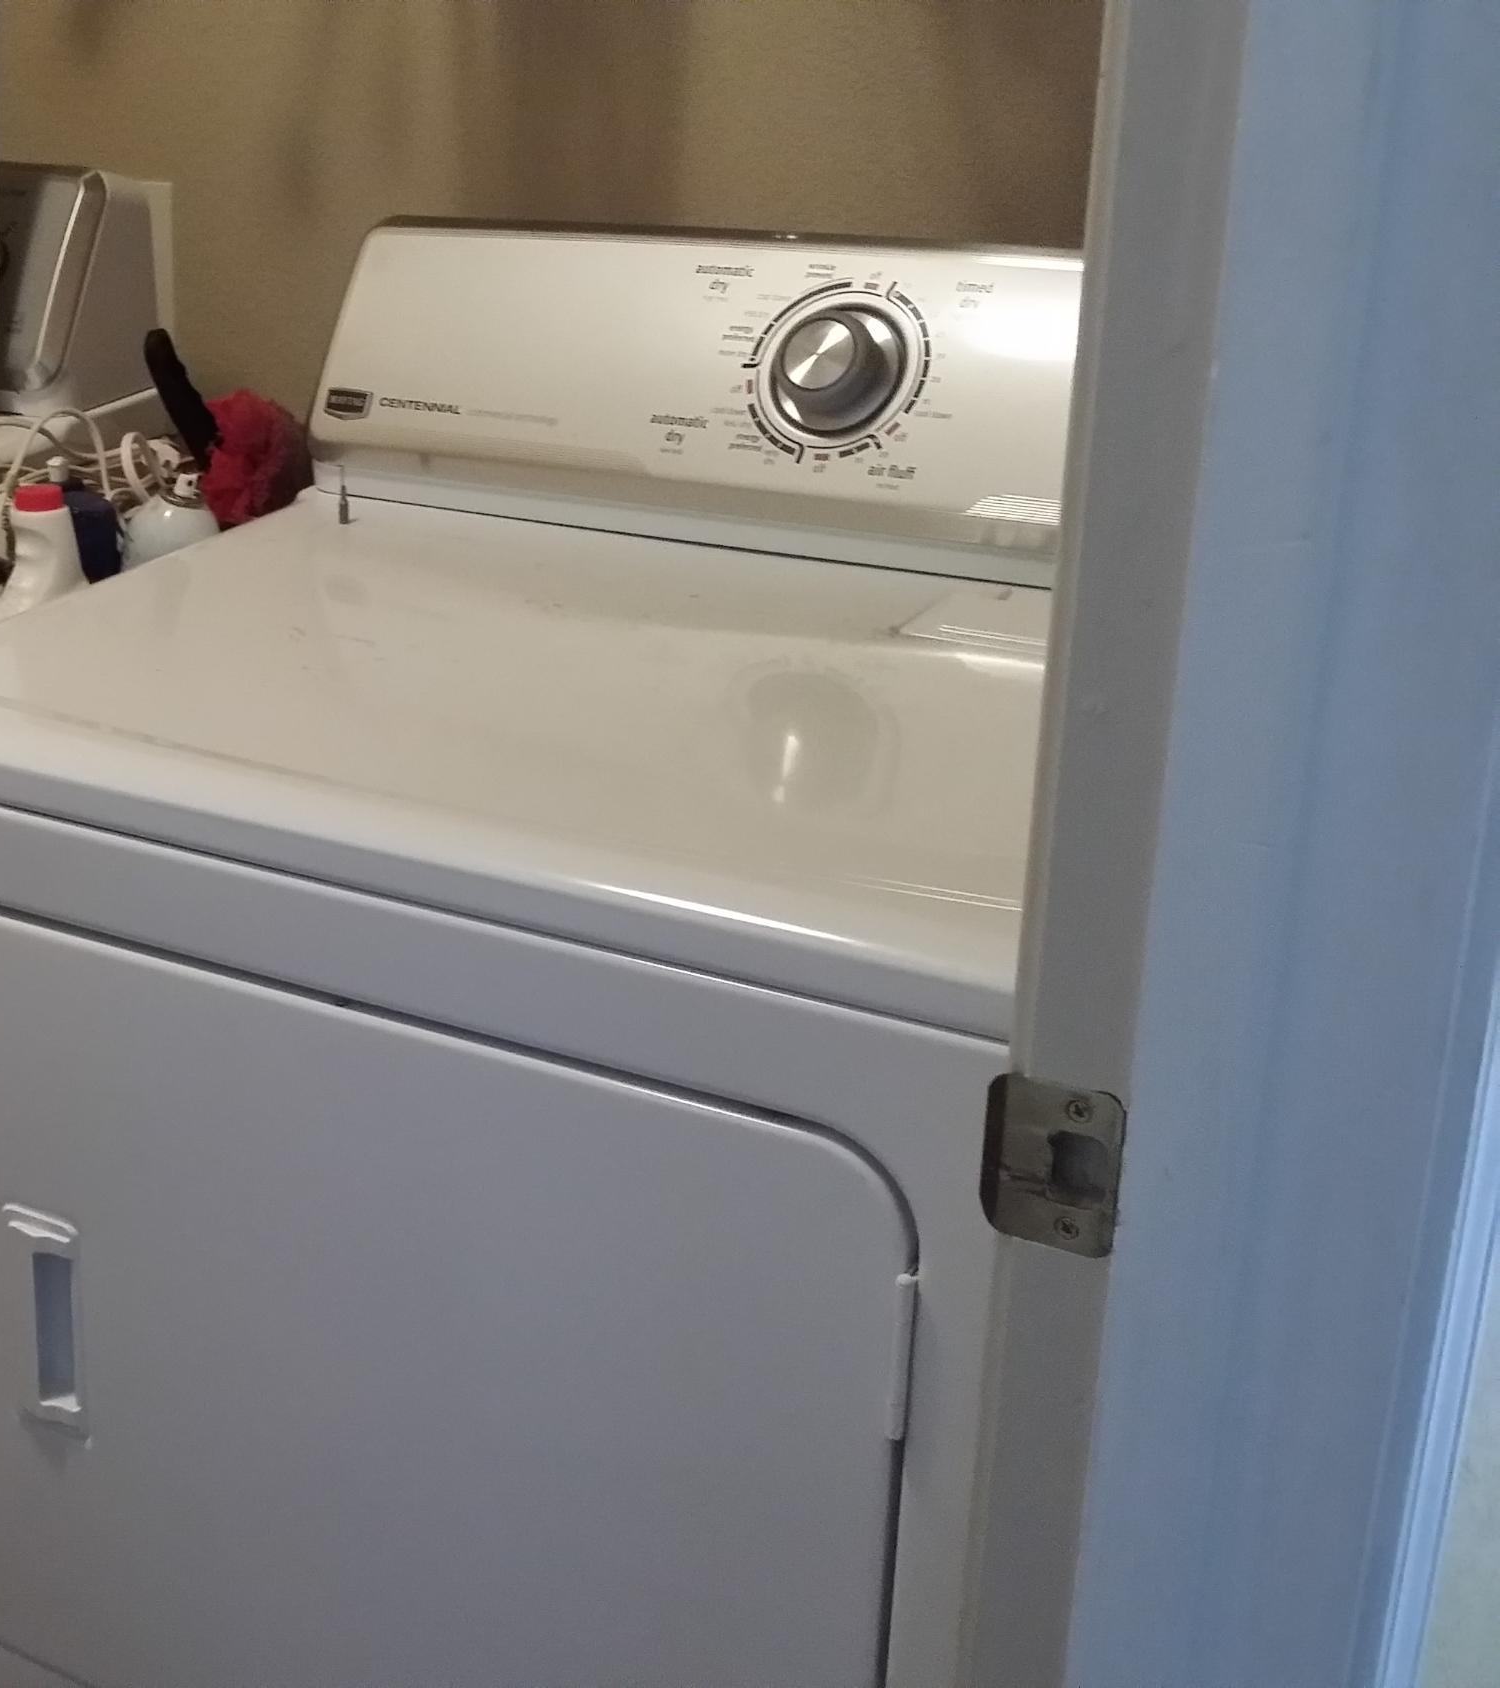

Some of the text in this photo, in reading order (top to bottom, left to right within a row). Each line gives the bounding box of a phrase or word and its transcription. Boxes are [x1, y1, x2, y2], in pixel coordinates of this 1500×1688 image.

[695, 264, 754, 278] automatic
[708, 279, 729, 294] dry
[955, 280, 995, 294] timed
[378, 396, 461, 415] CENTENNIAL
[649, 413, 709, 429] automatic
[664, 429, 686, 446] dry
[867, 463, 917, 480] air fluff
